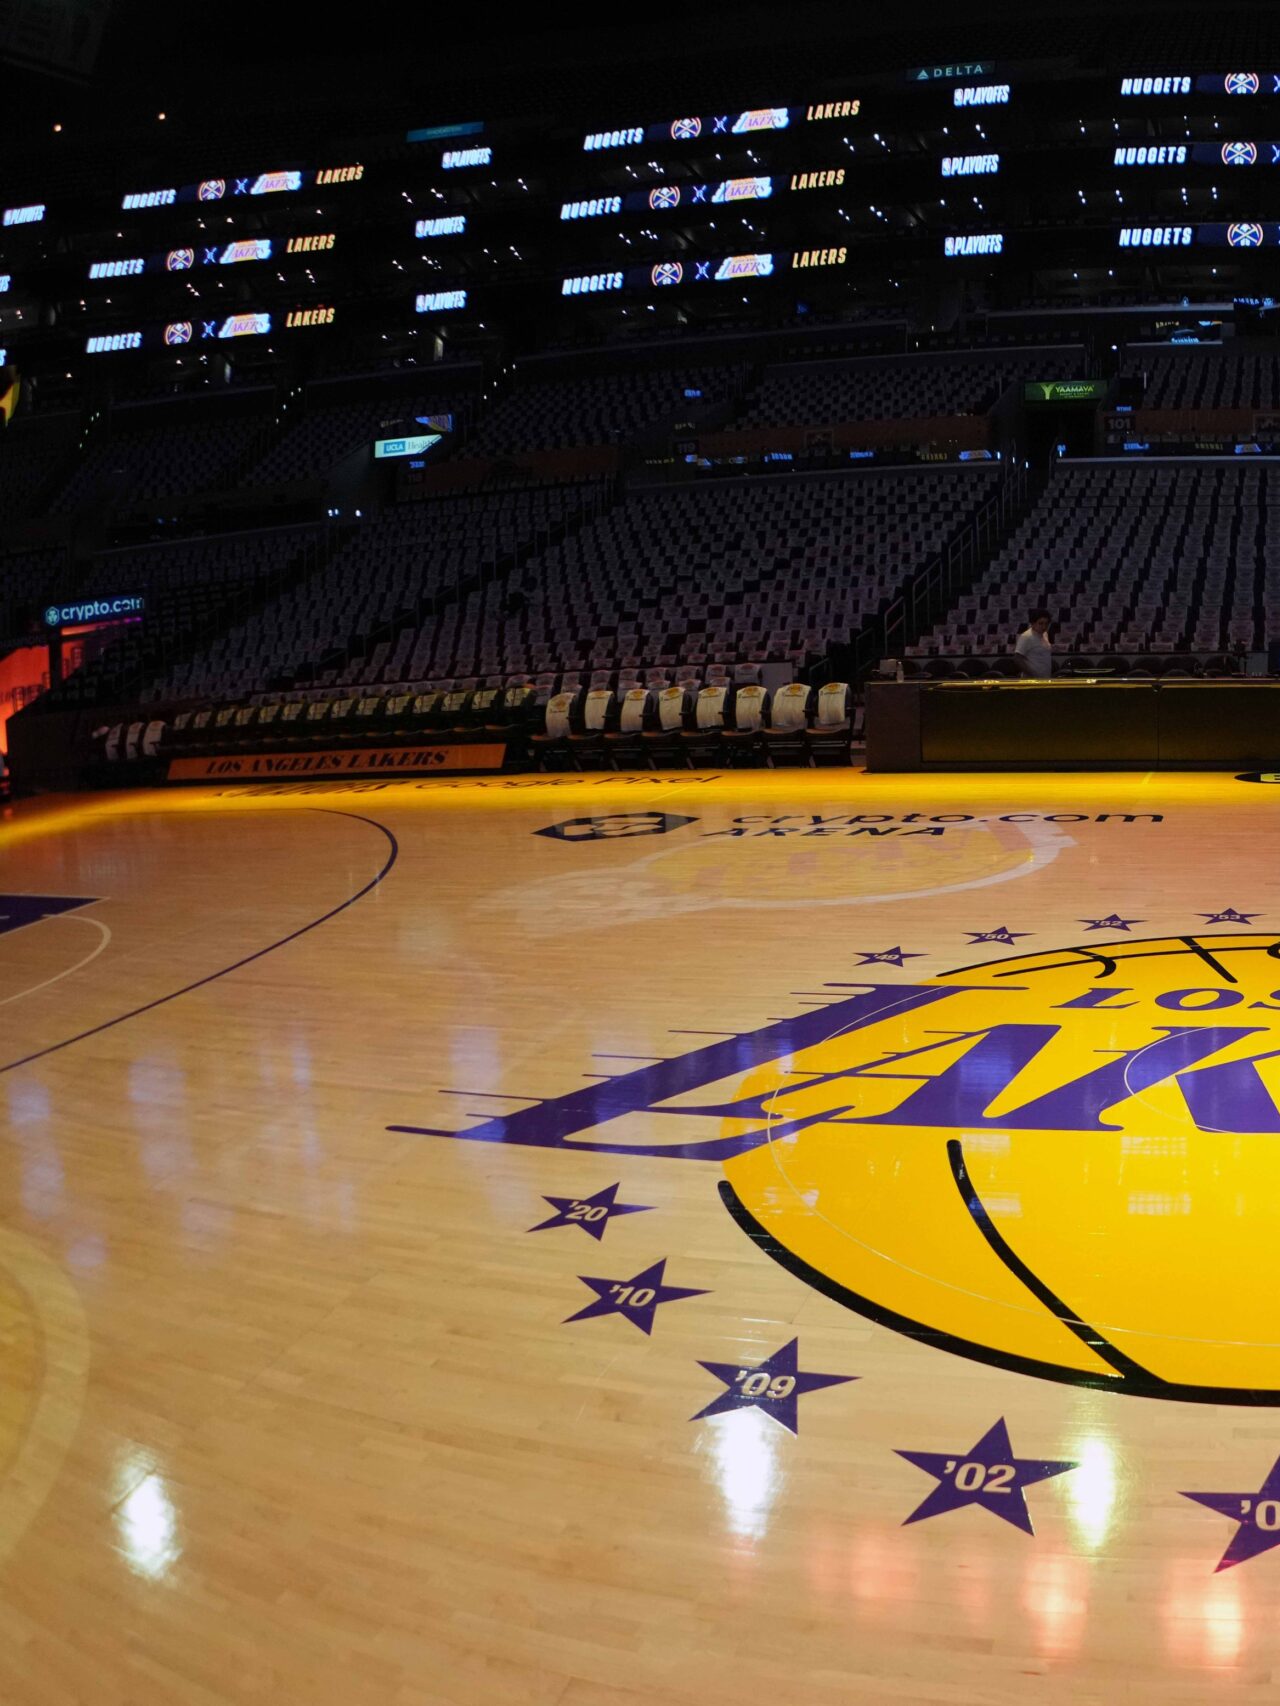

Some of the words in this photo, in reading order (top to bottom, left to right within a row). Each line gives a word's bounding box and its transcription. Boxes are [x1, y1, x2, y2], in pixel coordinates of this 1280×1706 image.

[933, 64, 984, 78] DELTA
[962, 85, 1010, 104] PLAYOFFS
[1121, 77, 1191, 95] NUGGETS
[584, 128, 644, 150] NUGGETS
[807, 100, 860, 120] LAKERS
[451, 148, 492, 167] PLAYOFFS
[952, 154, 999, 175] PLAYOFFS
[1114, 146, 1186, 165] NUGGETS
[123, 189, 176, 209] NUGGETS
[317, 166, 363, 184] LAKERS
[560, 196, 622, 220] NUGGETS
[791, 169, 845, 190] LAKERS
[424, 216, 466, 236] PLAYOFFS
[955, 234, 1003, 254] PLAYOFFS
[1119, 227, 1192, 246] NUGGETS
[89, 259, 144, 279] NUGGETS
[287, 234, 335, 253] LAKERS
[562, 272, 624, 295] NUGGETS
[793, 248, 846, 268] LAKERS
[424, 290, 467, 310] PLAYOFFS
[87, 332, 142, 353] NUGGETS
[287, 308, 334, 327] LAKERS
[1106, 418, 1131, 430] 101
[385, 443, 404, 452] UCLA
[206, 758, 243, 774] LOS
[253, 752, 342, 772] ANGELES
[348, 749, 447, 768] LAKERS
[415, 778, 585, 789] Google
[593, 775, 723, 785] Pixel
[733, 811, 1164, 826] crypto.com
[701, 826, 946, 837] ARENA
[568, 1201, 608, 1221] '20
[610, 1284, 656, 1307] '10
[735, 1370, 797, 1399] '09
[944, 1461, 1016, 1494] '02
